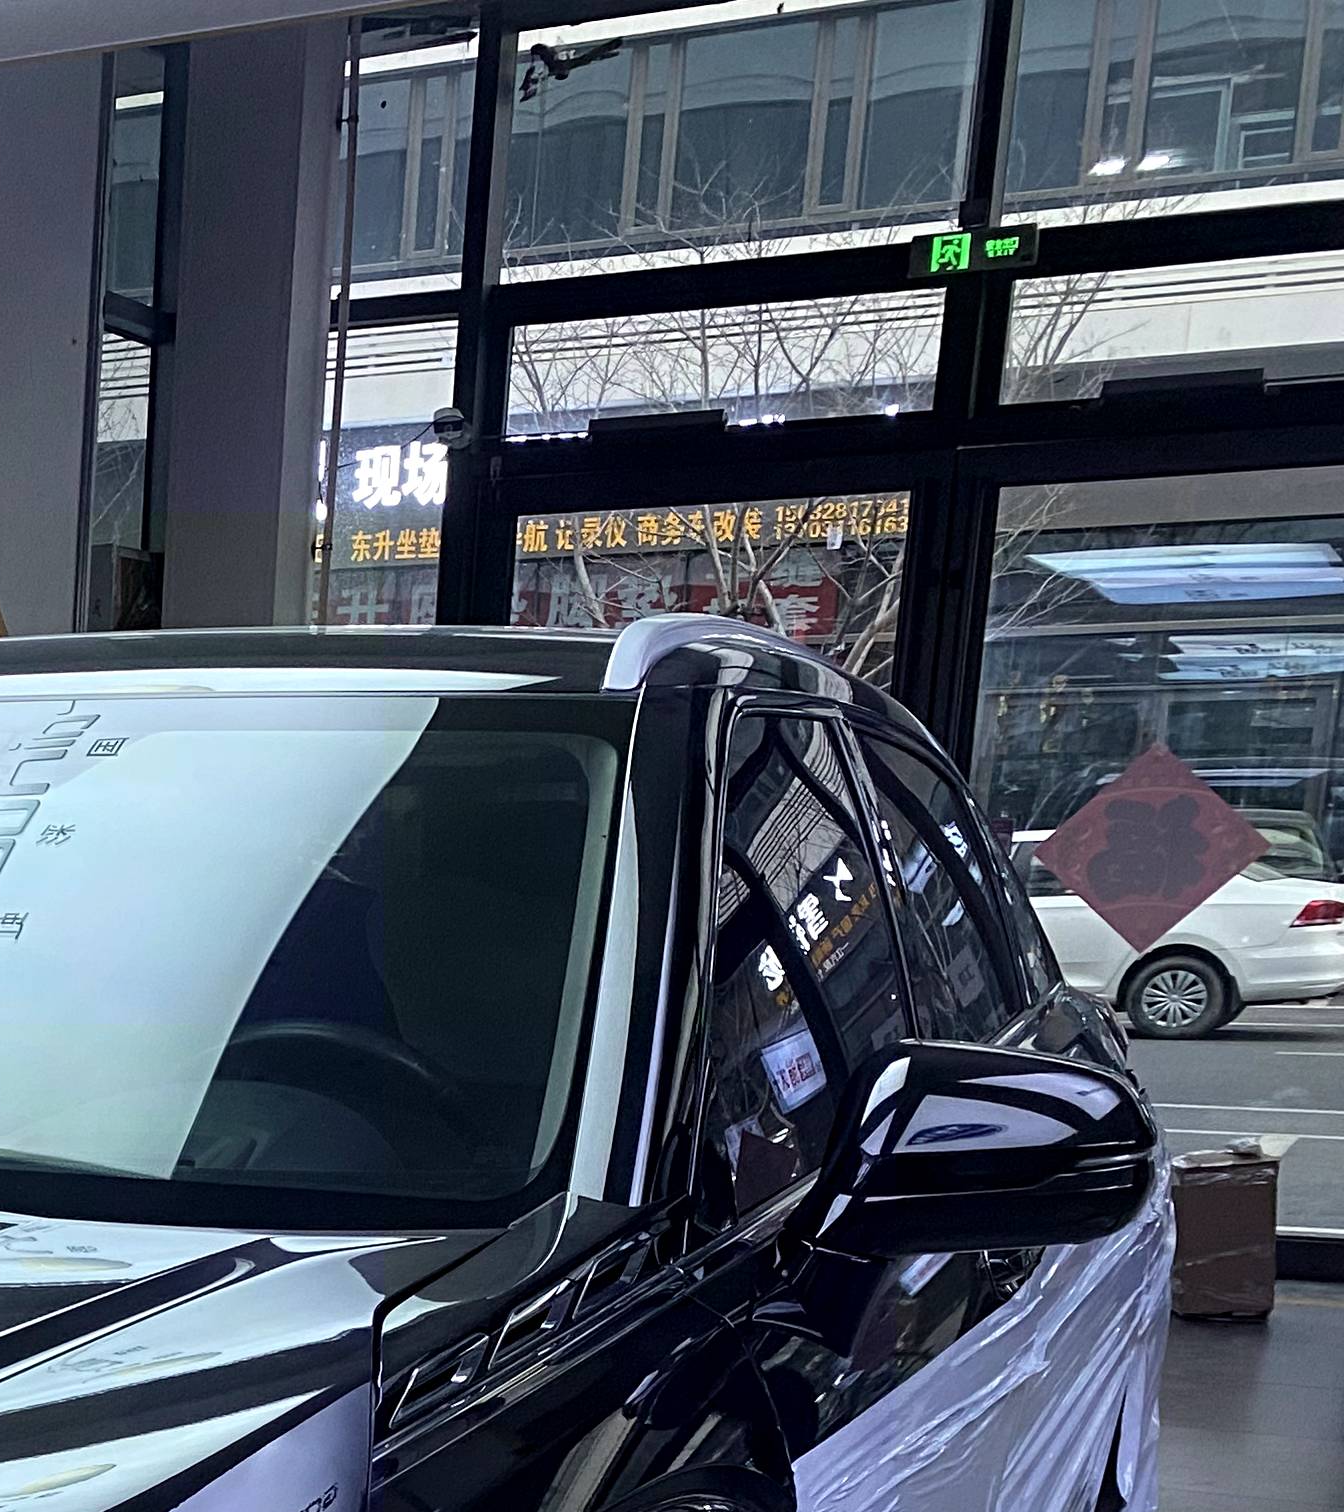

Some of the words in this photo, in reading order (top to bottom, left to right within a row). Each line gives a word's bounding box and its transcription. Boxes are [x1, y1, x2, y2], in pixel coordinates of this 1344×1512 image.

[350, 527, 441, 561] 东升坐垫
[555, 514, 628, 551] 记录仪
